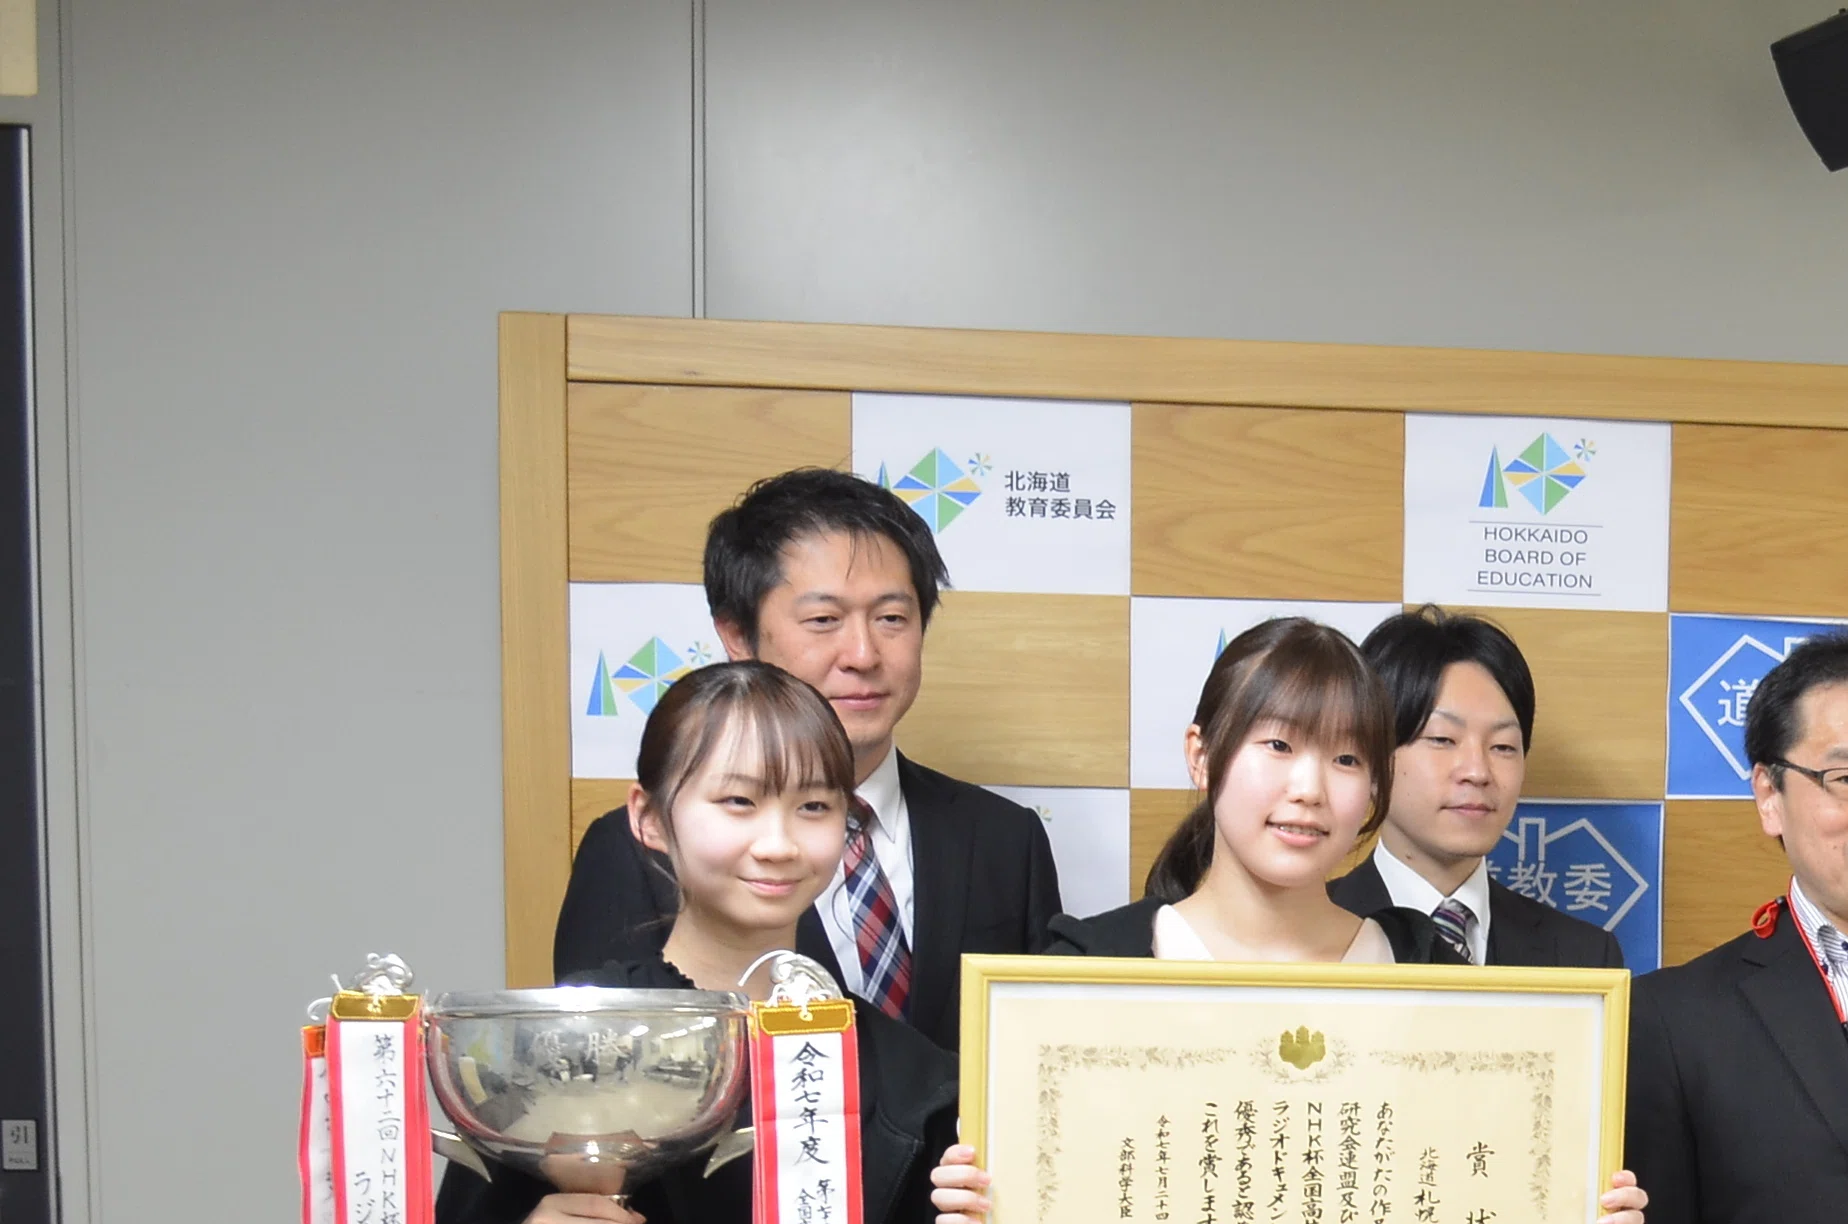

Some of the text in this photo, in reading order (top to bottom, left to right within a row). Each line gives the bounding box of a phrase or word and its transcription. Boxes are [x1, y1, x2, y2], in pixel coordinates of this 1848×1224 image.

[1004, 470, 1070, 493] 北海道
[1005, 496, 1116, 520] 教育委員会
[1483, 526, 1588, 544] HOKKAIDO
[1485, 548, 1586, 566] BOARD OF
[1477, 570, 1592, 588] EDUCATION
[1486, 860, 1612, 912] 教委
[789, 1041, 830, 1165] 令和七年度
[1118, 1137, 1135, 1219] 文部科学大臣
